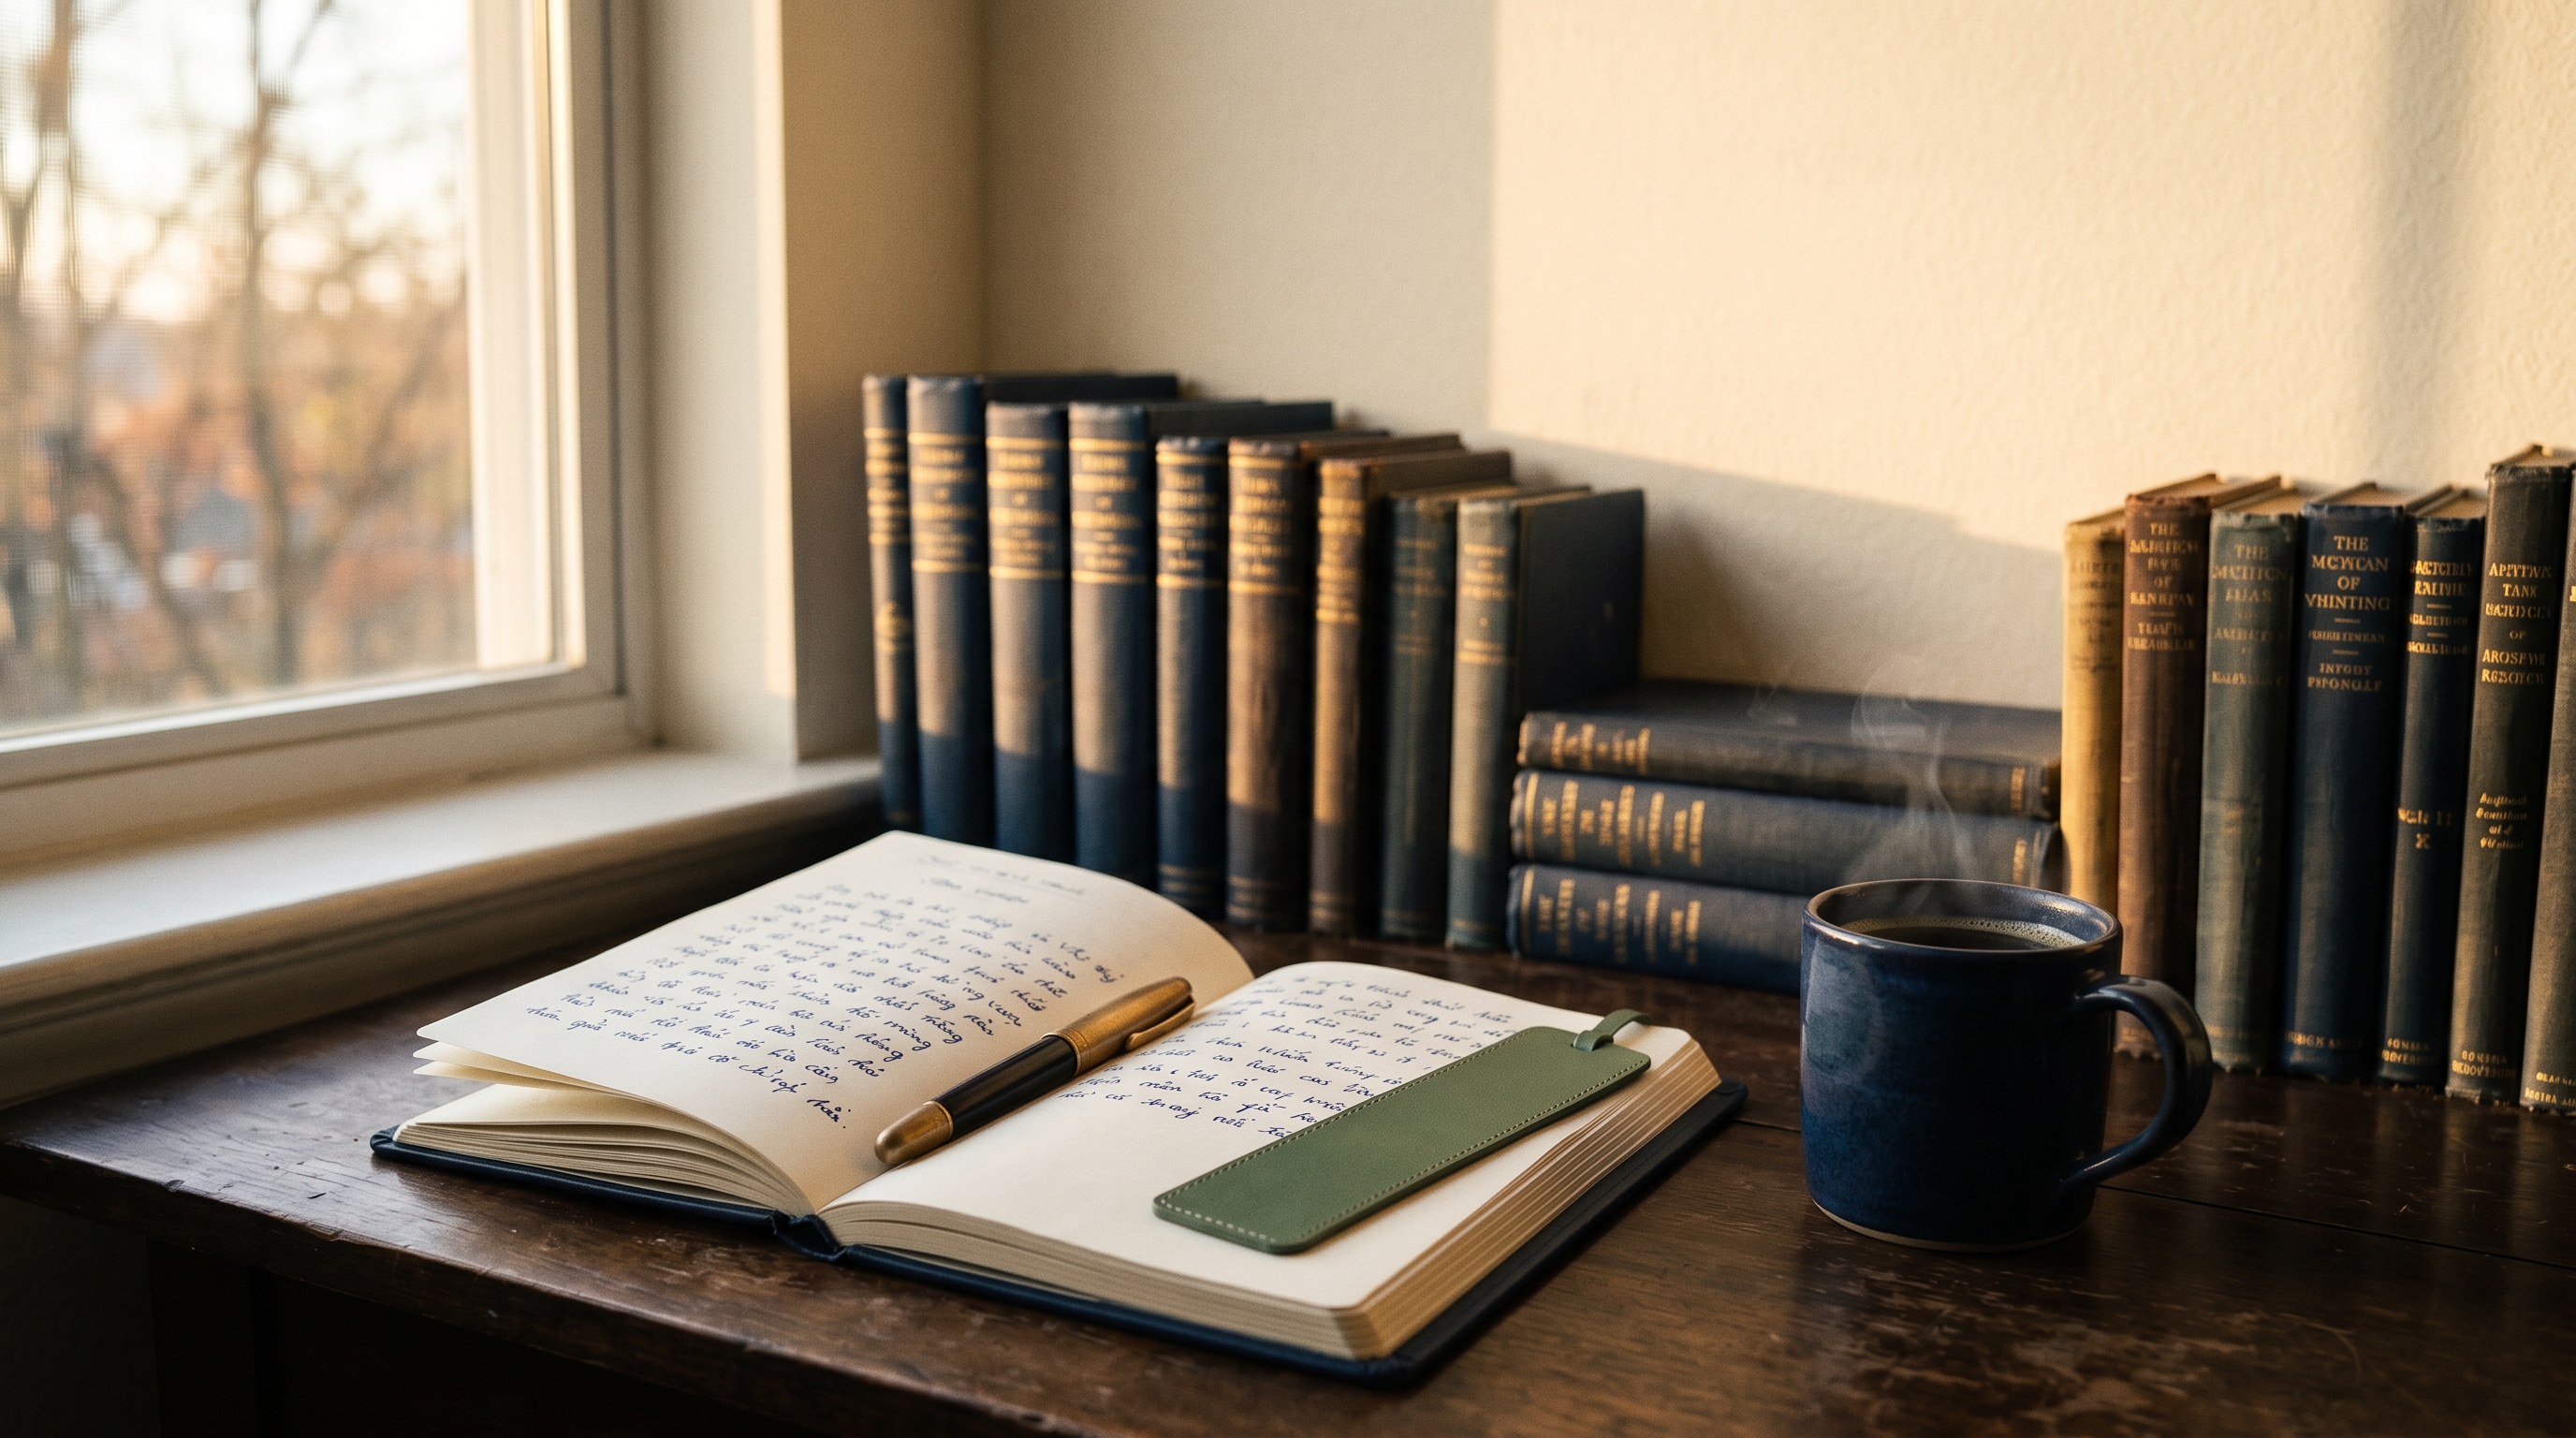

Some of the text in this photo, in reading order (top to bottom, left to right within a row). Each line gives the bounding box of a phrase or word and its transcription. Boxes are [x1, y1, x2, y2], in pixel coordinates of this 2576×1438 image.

[2150, 522, 2180, 537] THE
[2333, 535, 2369, 551] THE
[2234, 544, 2270, 561] THE
[2336, 575, 2362, 591] OF
[2502, 582, 2539, 599] TANK
[2509, 630, 2528, 641] OF
